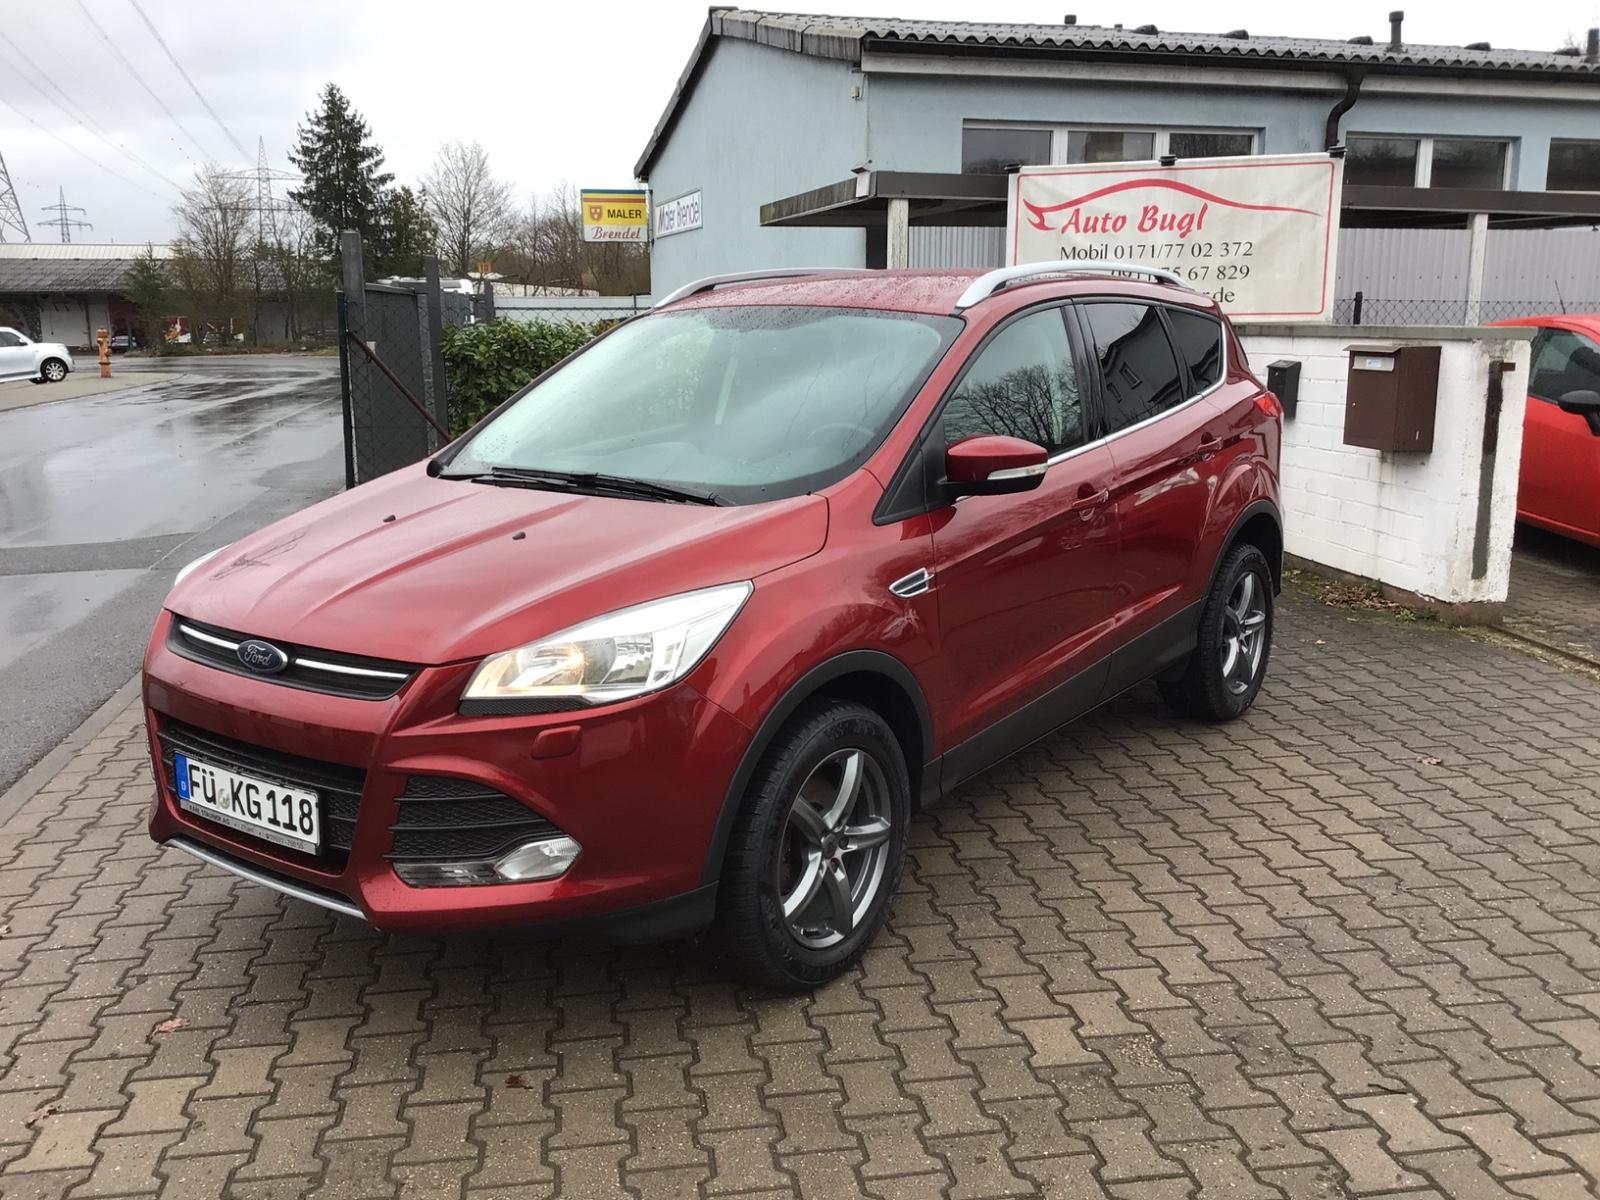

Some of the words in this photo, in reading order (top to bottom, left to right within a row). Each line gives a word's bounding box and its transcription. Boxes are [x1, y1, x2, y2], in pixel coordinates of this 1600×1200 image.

[607, 209, 642, 219] MALER
[1061, 207, 1127, 234] Auto
[1137, 202, 1208, 239] Bugl
[592, 227, 640, 239] Brendel
[1060, 244, 1108, 260] Mobil
[1114, 243, 1184, 259] 0171/77
[1191, 243, 1213, 258] 02
[1220, 241, 1254, 257] 372
[1188, 266, 1209, 280] 67
[1216, 265, 1250, 279] 829
[244, 644, 272, 666] Ford
